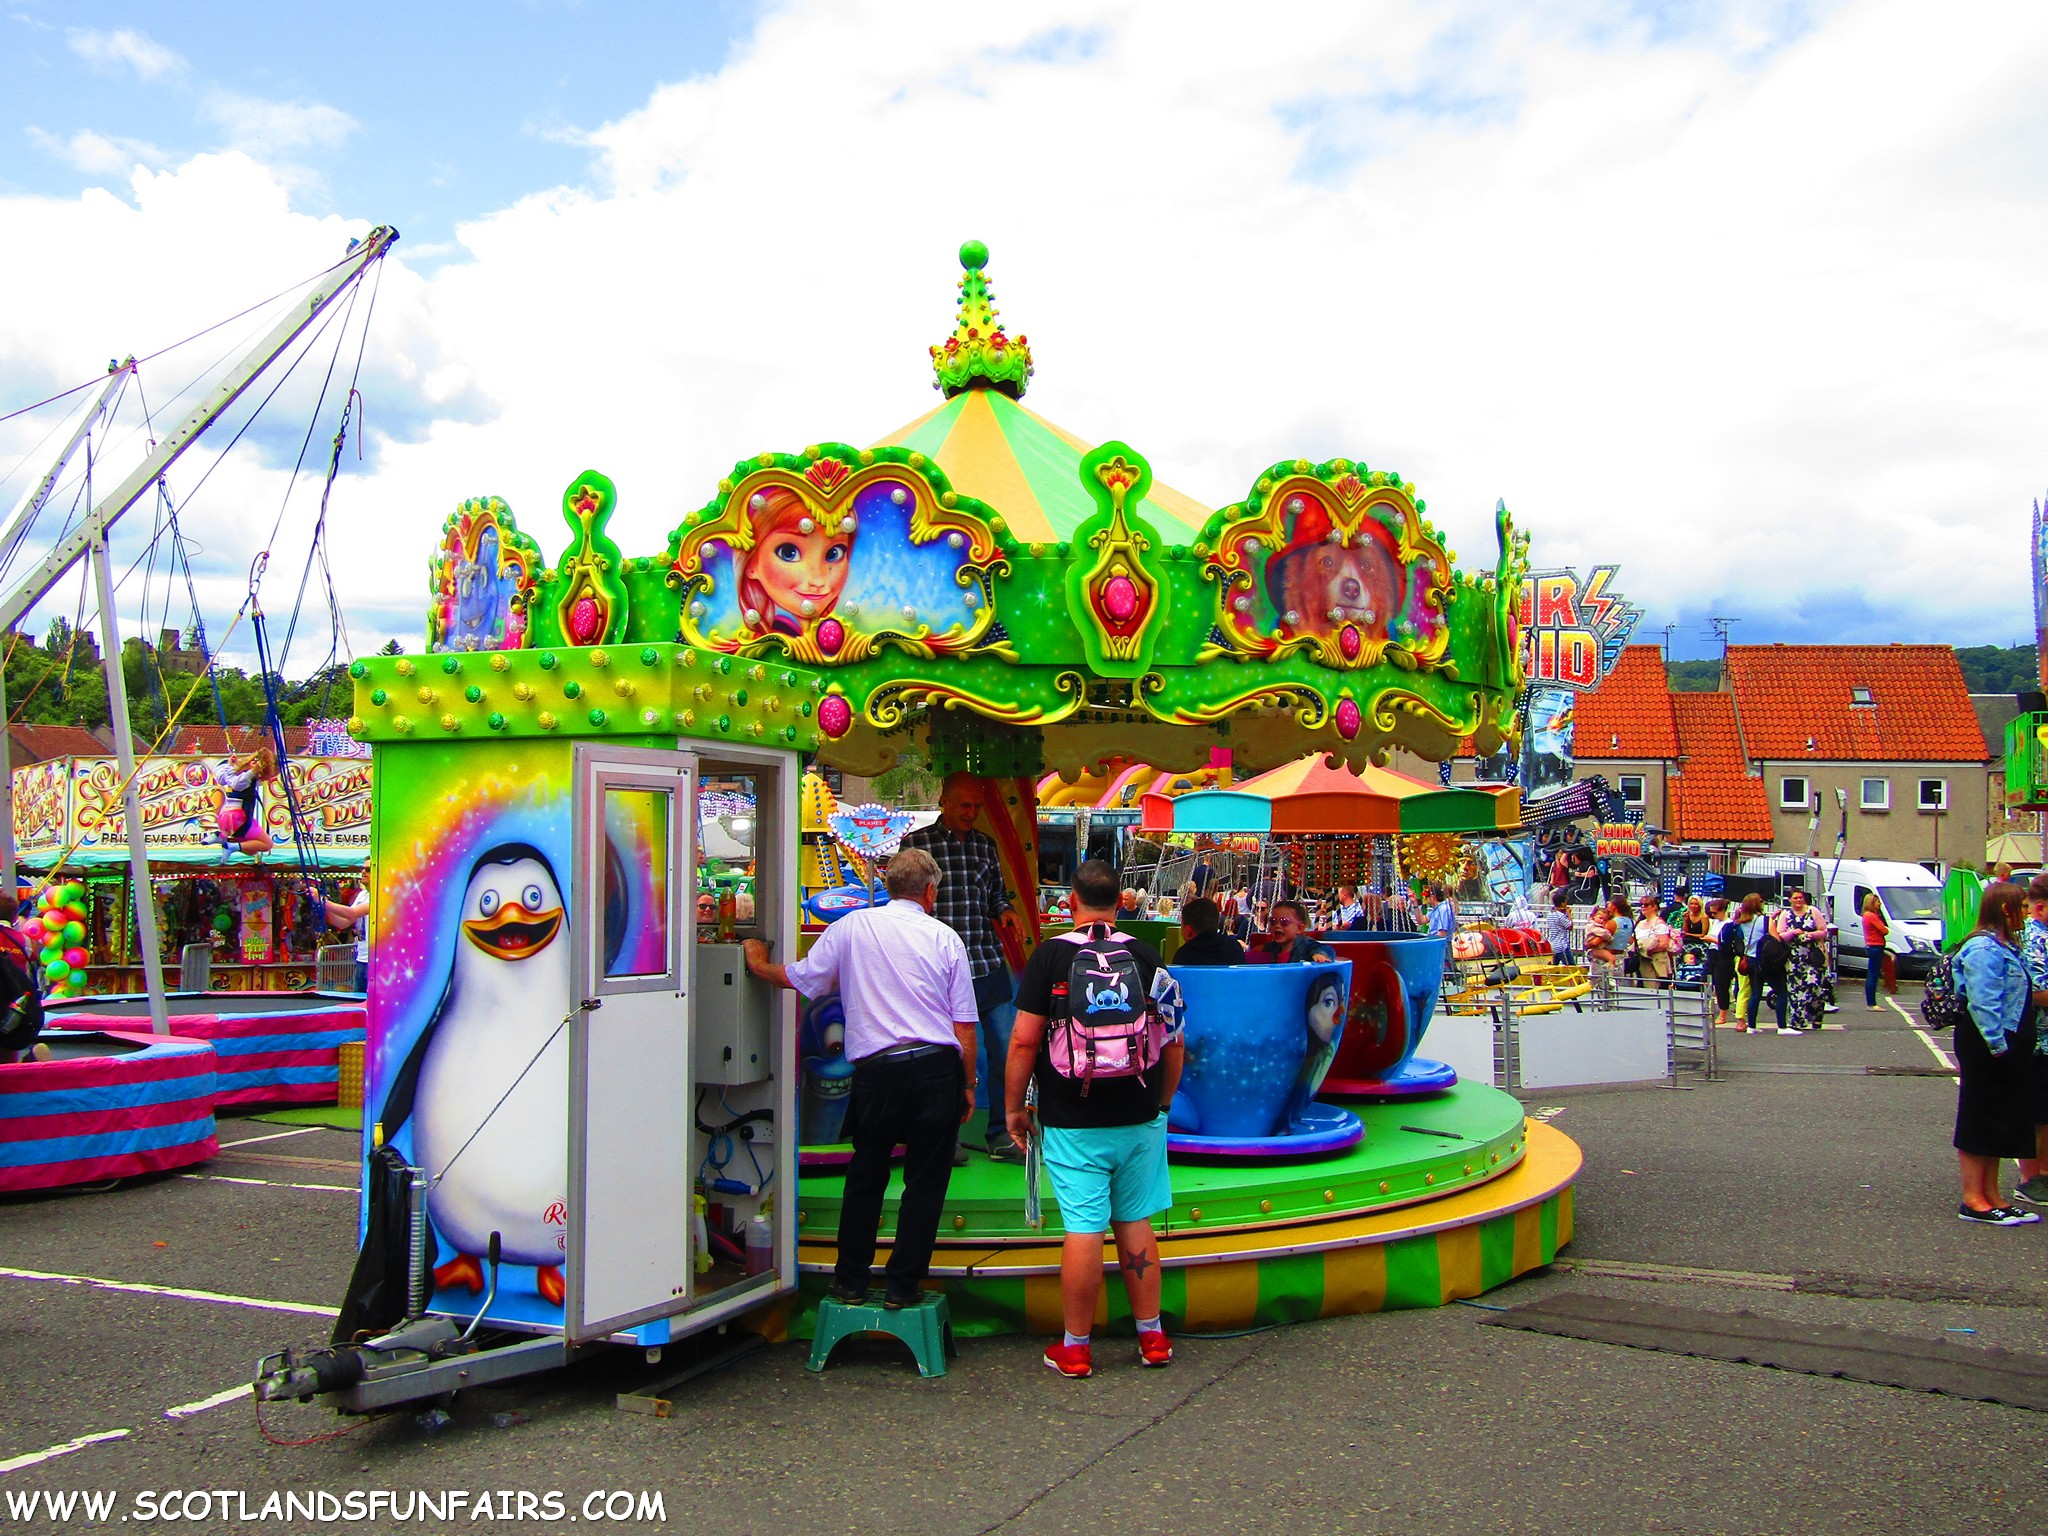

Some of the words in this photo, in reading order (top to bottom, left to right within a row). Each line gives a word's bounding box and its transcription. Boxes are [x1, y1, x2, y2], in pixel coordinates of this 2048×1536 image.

[1520, 575, 1579, 627] IR
[1522, 630, 1598, 688] ID
[143, 788, 217, 824] DUCK
[102, 833, 129, 843] PRIZ
[145, 834, 185, 843] EVERY
[1602, 823, 1635, 839] AIR
[1597, 839, 1640, 857] RAID
